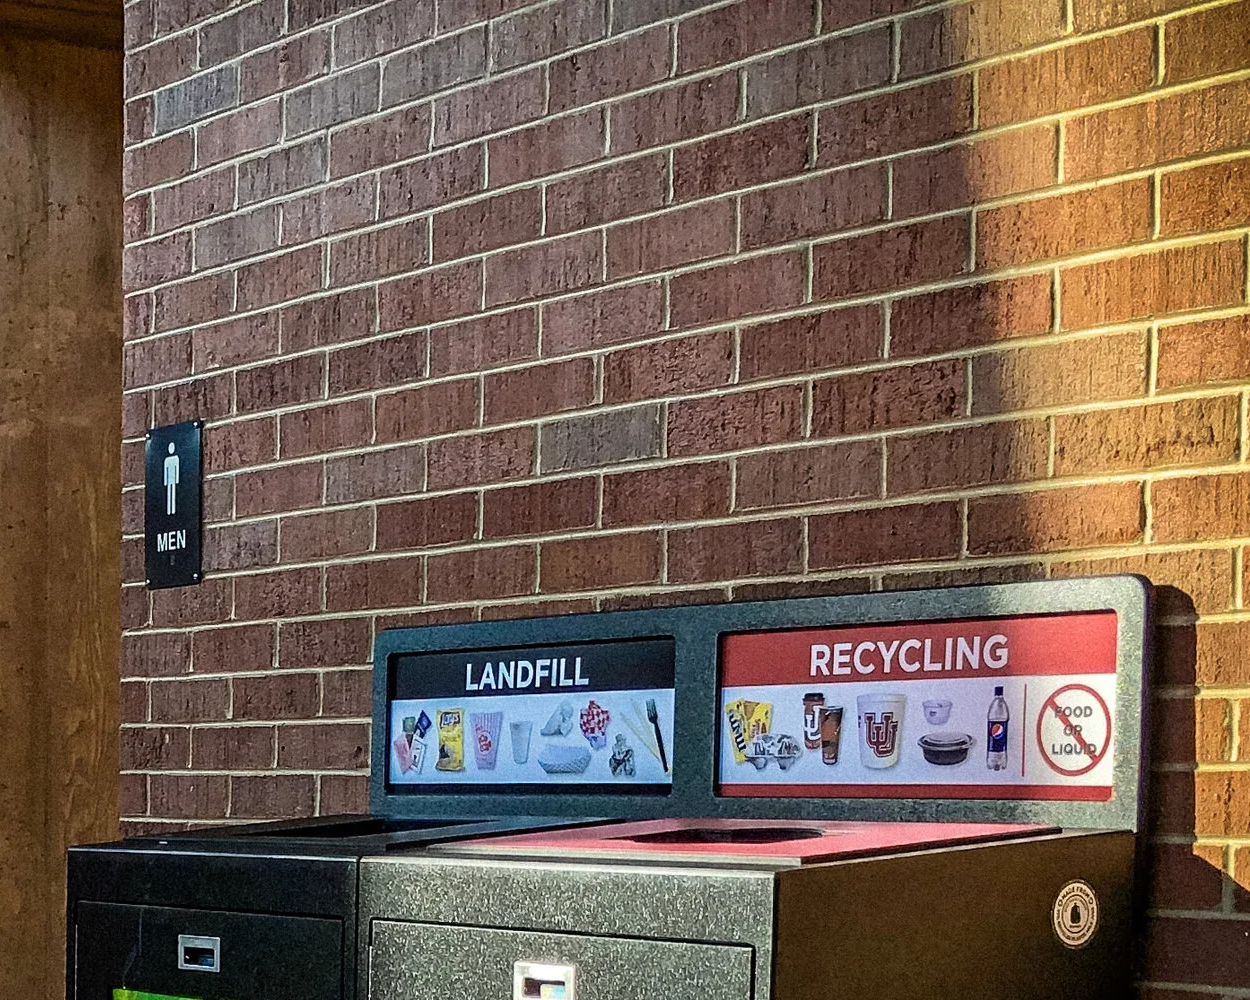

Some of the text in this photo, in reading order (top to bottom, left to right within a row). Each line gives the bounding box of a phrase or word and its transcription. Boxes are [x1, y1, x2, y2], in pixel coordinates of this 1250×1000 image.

[156, 529, 186, 553] MEN
[810, 634, 1009, 677] RECYCLING
[465, 657, 589, 691] LANDFILL
[1054, 706, 1093, 718] FOOD
[1063, 724, 1083, 737] OR
[1051, 743, 1097, 756] LIQUID
